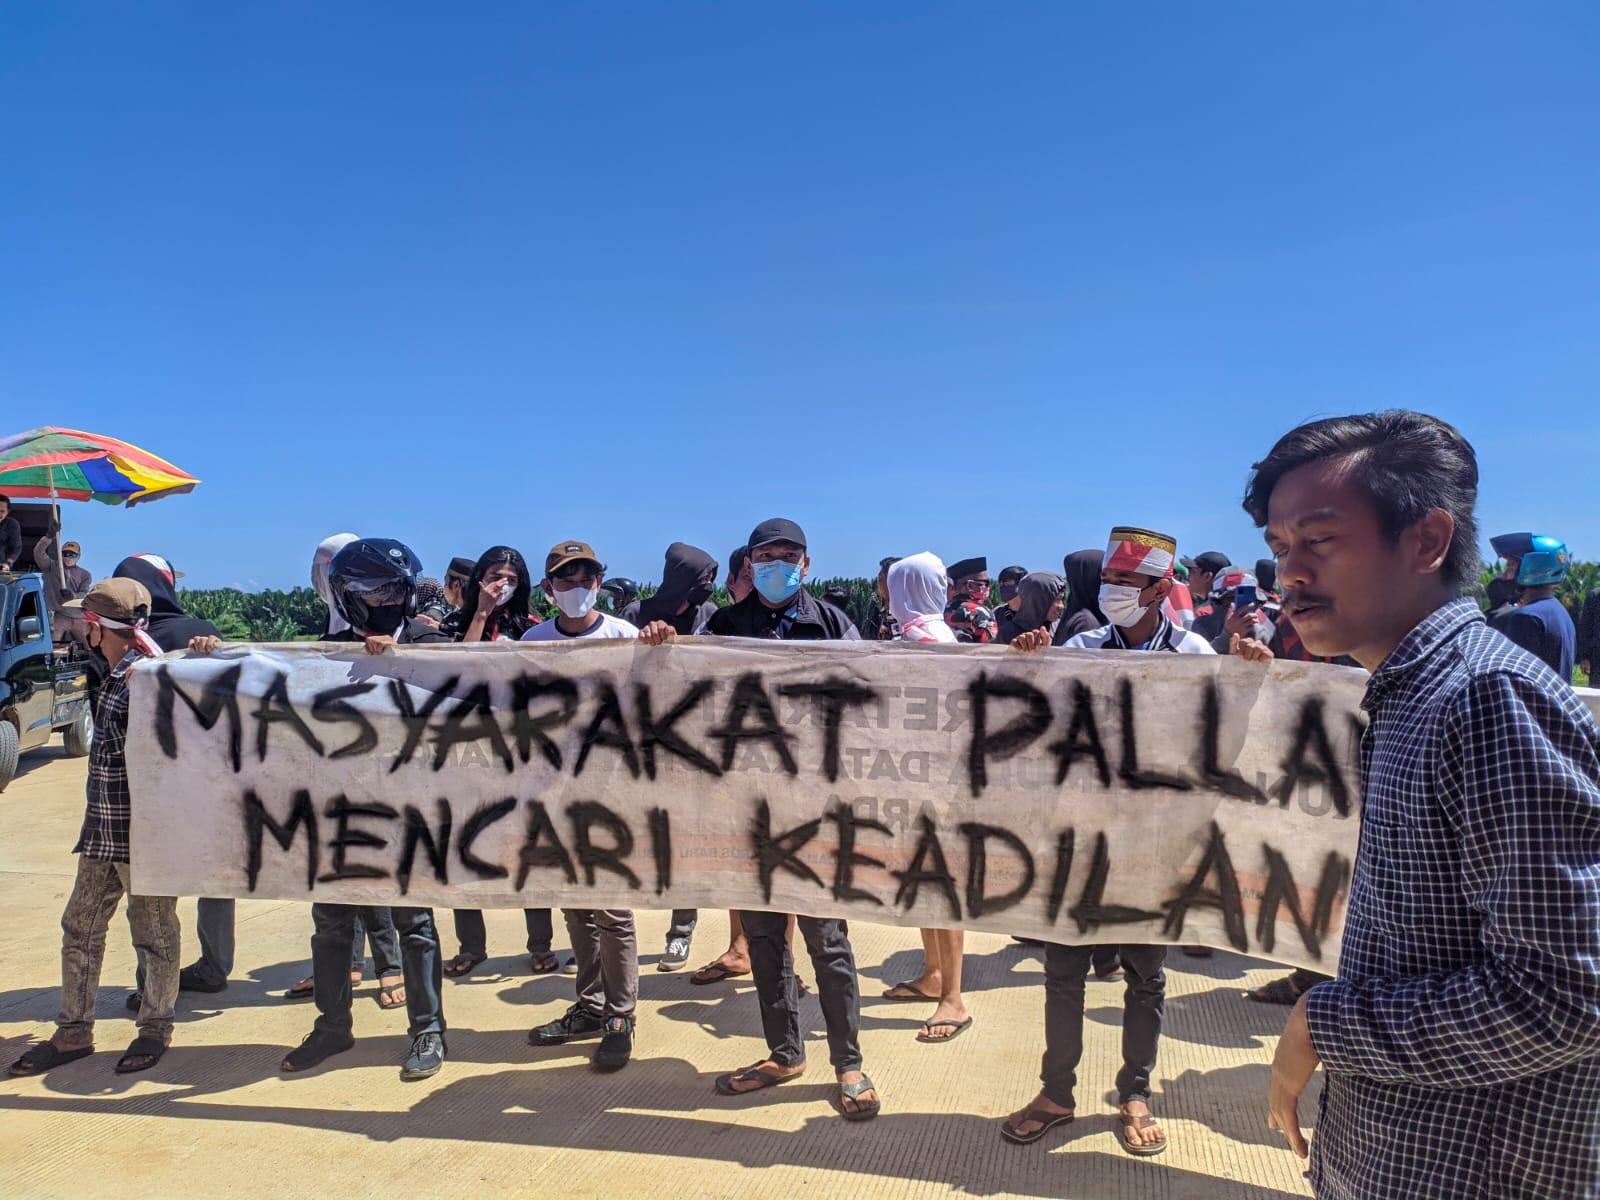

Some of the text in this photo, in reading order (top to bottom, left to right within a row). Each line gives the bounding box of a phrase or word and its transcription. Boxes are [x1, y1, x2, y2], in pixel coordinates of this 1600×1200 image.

[153, 660, 880, 784] MASYARAKAT
[242, 787, 1352, 962] MENCARI KEADILAN
